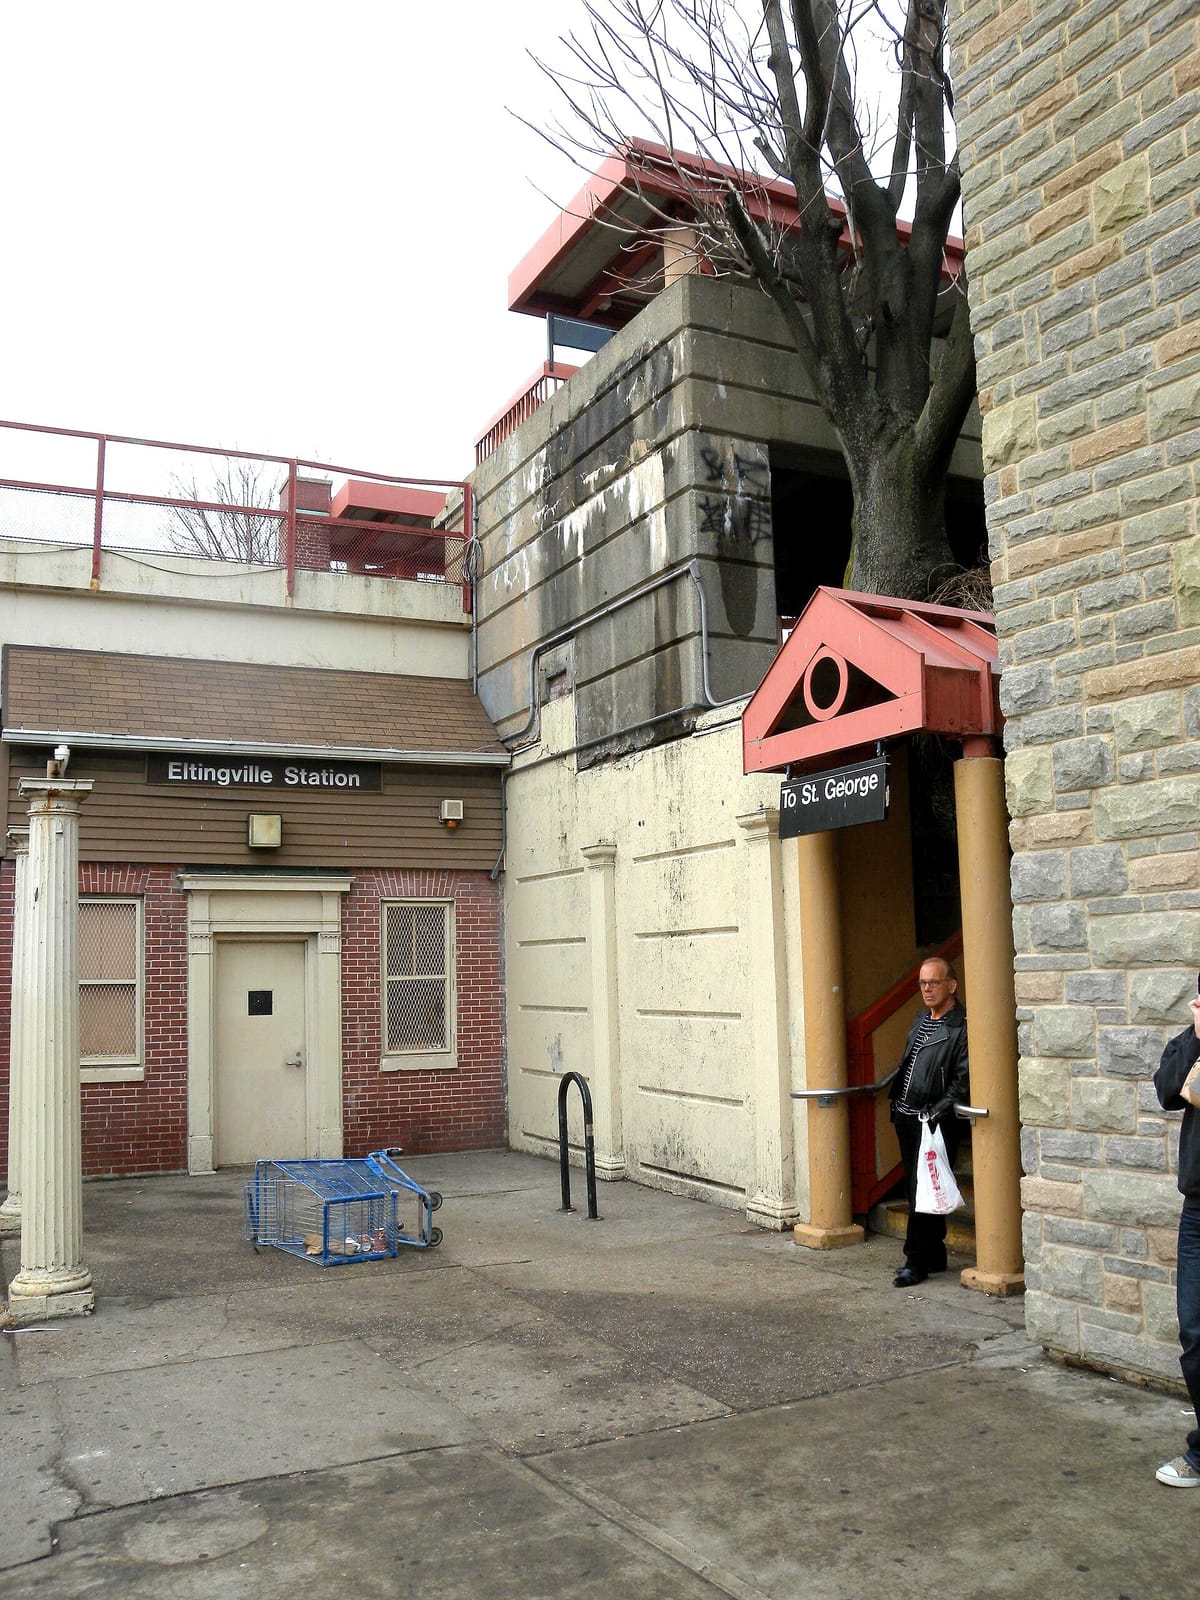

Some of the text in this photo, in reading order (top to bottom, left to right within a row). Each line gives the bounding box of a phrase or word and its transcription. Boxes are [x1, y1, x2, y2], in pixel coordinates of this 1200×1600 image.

[168, 762, 361, 787] Eltingville Station
[781, 773, 879, 809] To St. George
